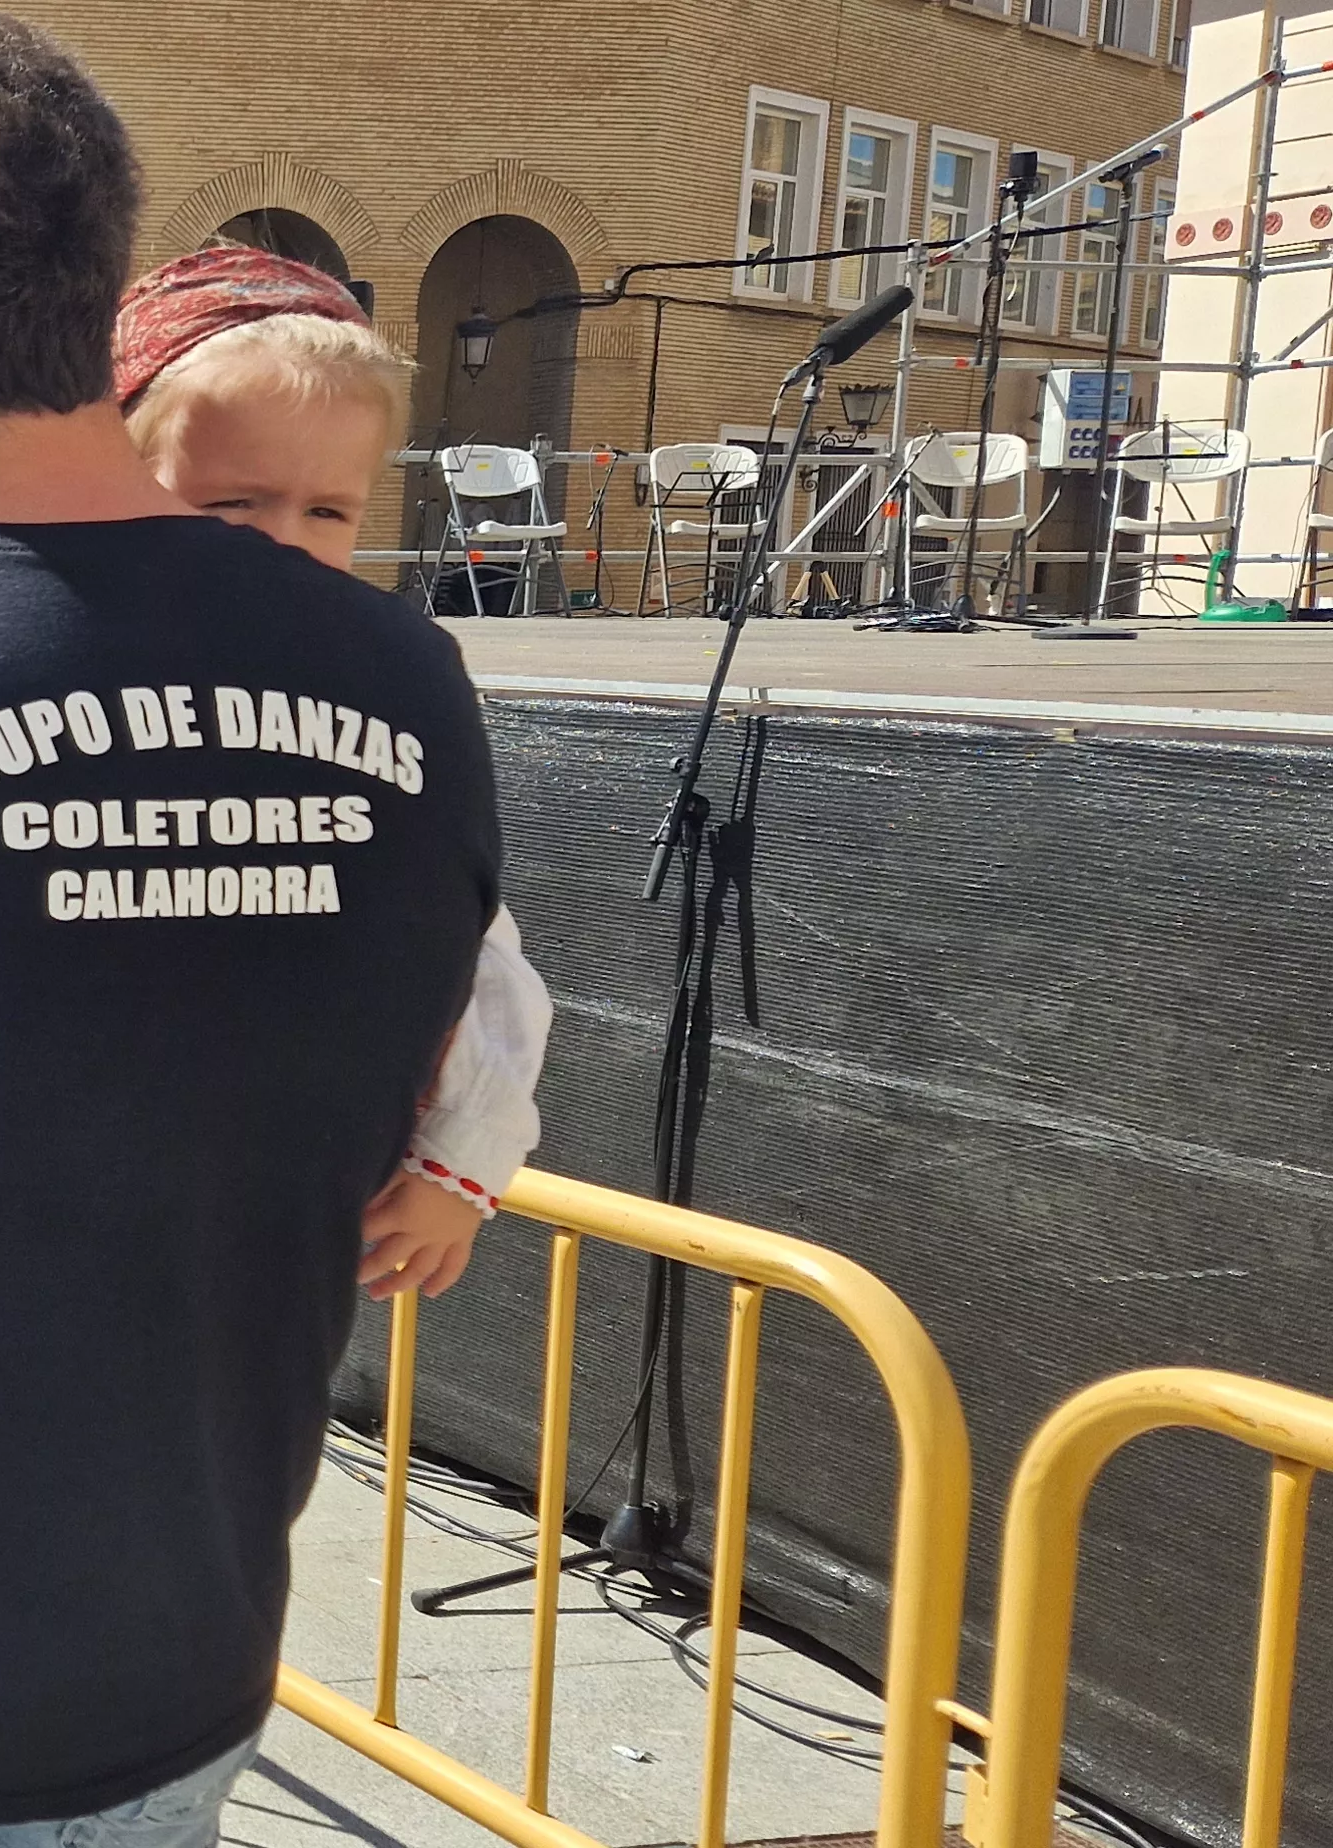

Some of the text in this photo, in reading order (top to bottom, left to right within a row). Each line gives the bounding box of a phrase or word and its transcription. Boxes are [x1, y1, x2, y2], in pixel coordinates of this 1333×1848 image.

[120, 685, 204, 751] DE
[214, 686, 425, 796] DANZAS
[1, 795, 375, 851] COLETORES
[46, 864, 341, 922] CALAHORRA
